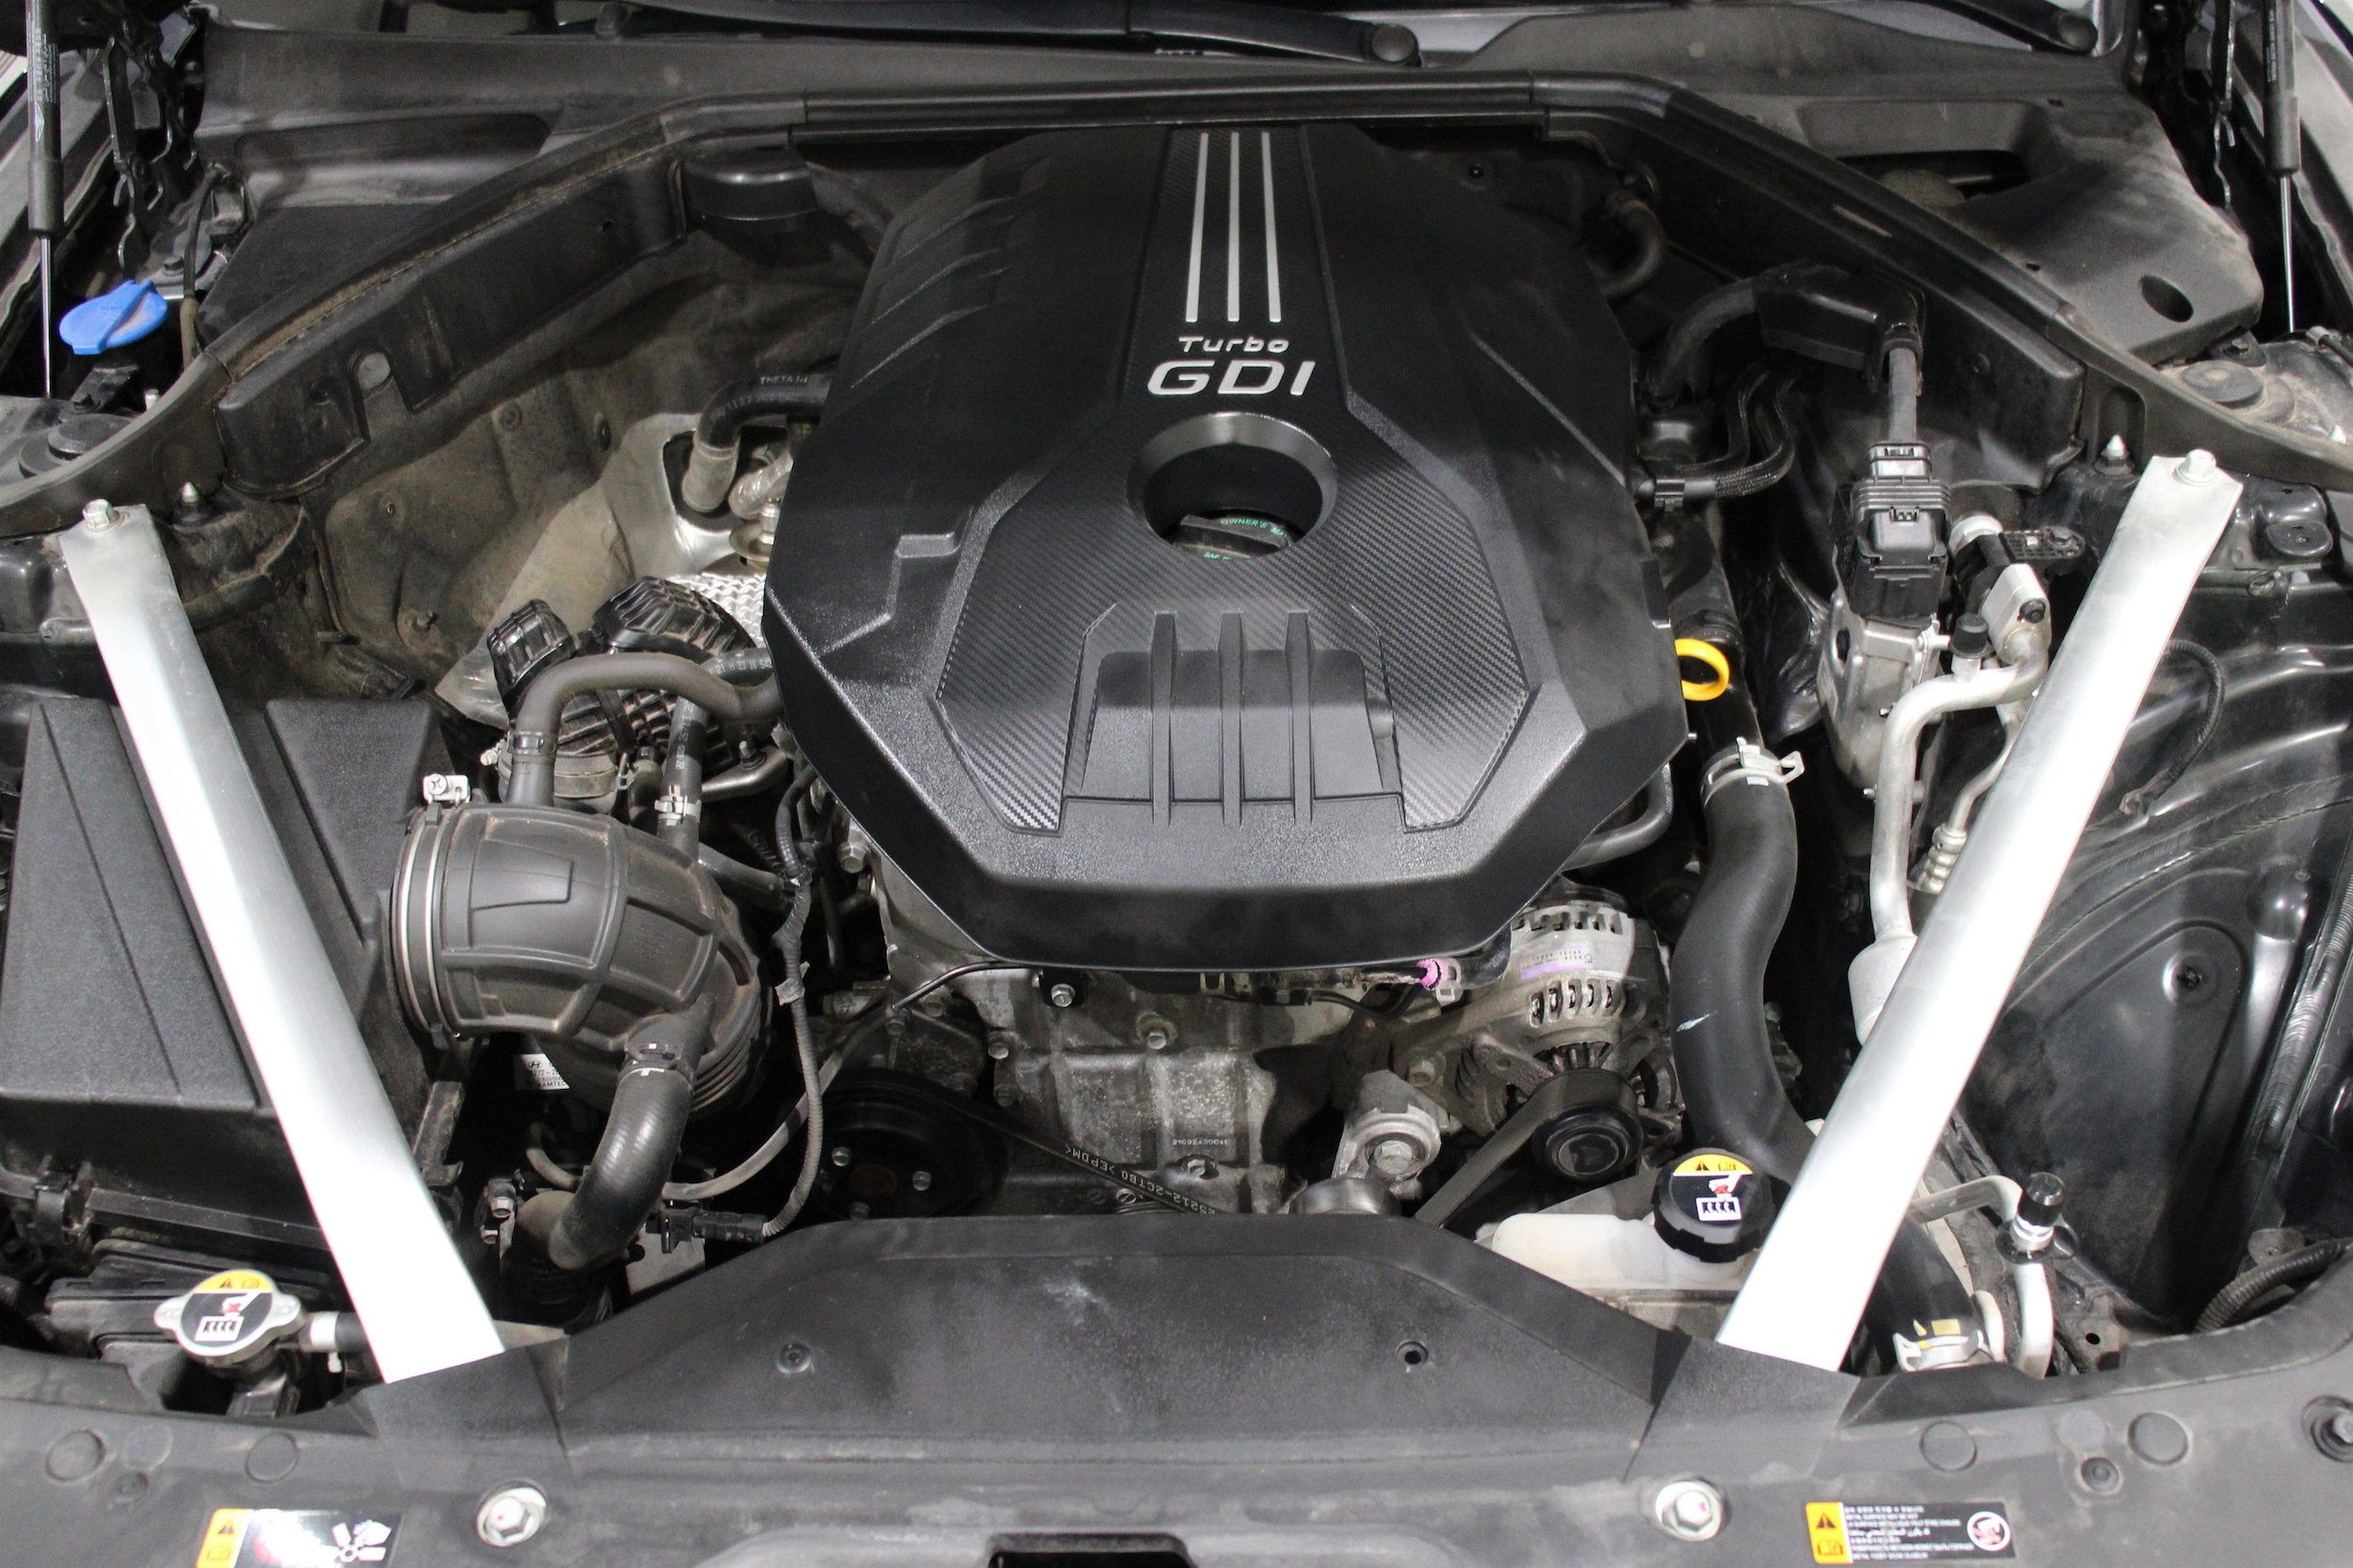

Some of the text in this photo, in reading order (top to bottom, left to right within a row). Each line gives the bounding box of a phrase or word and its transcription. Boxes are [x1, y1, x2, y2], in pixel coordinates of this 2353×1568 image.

[1178, 335, 1289, 354] Turbo
[1147, 360, 1316, 396] GDI
[1221, 518, 1270, 529] OWNER'S
